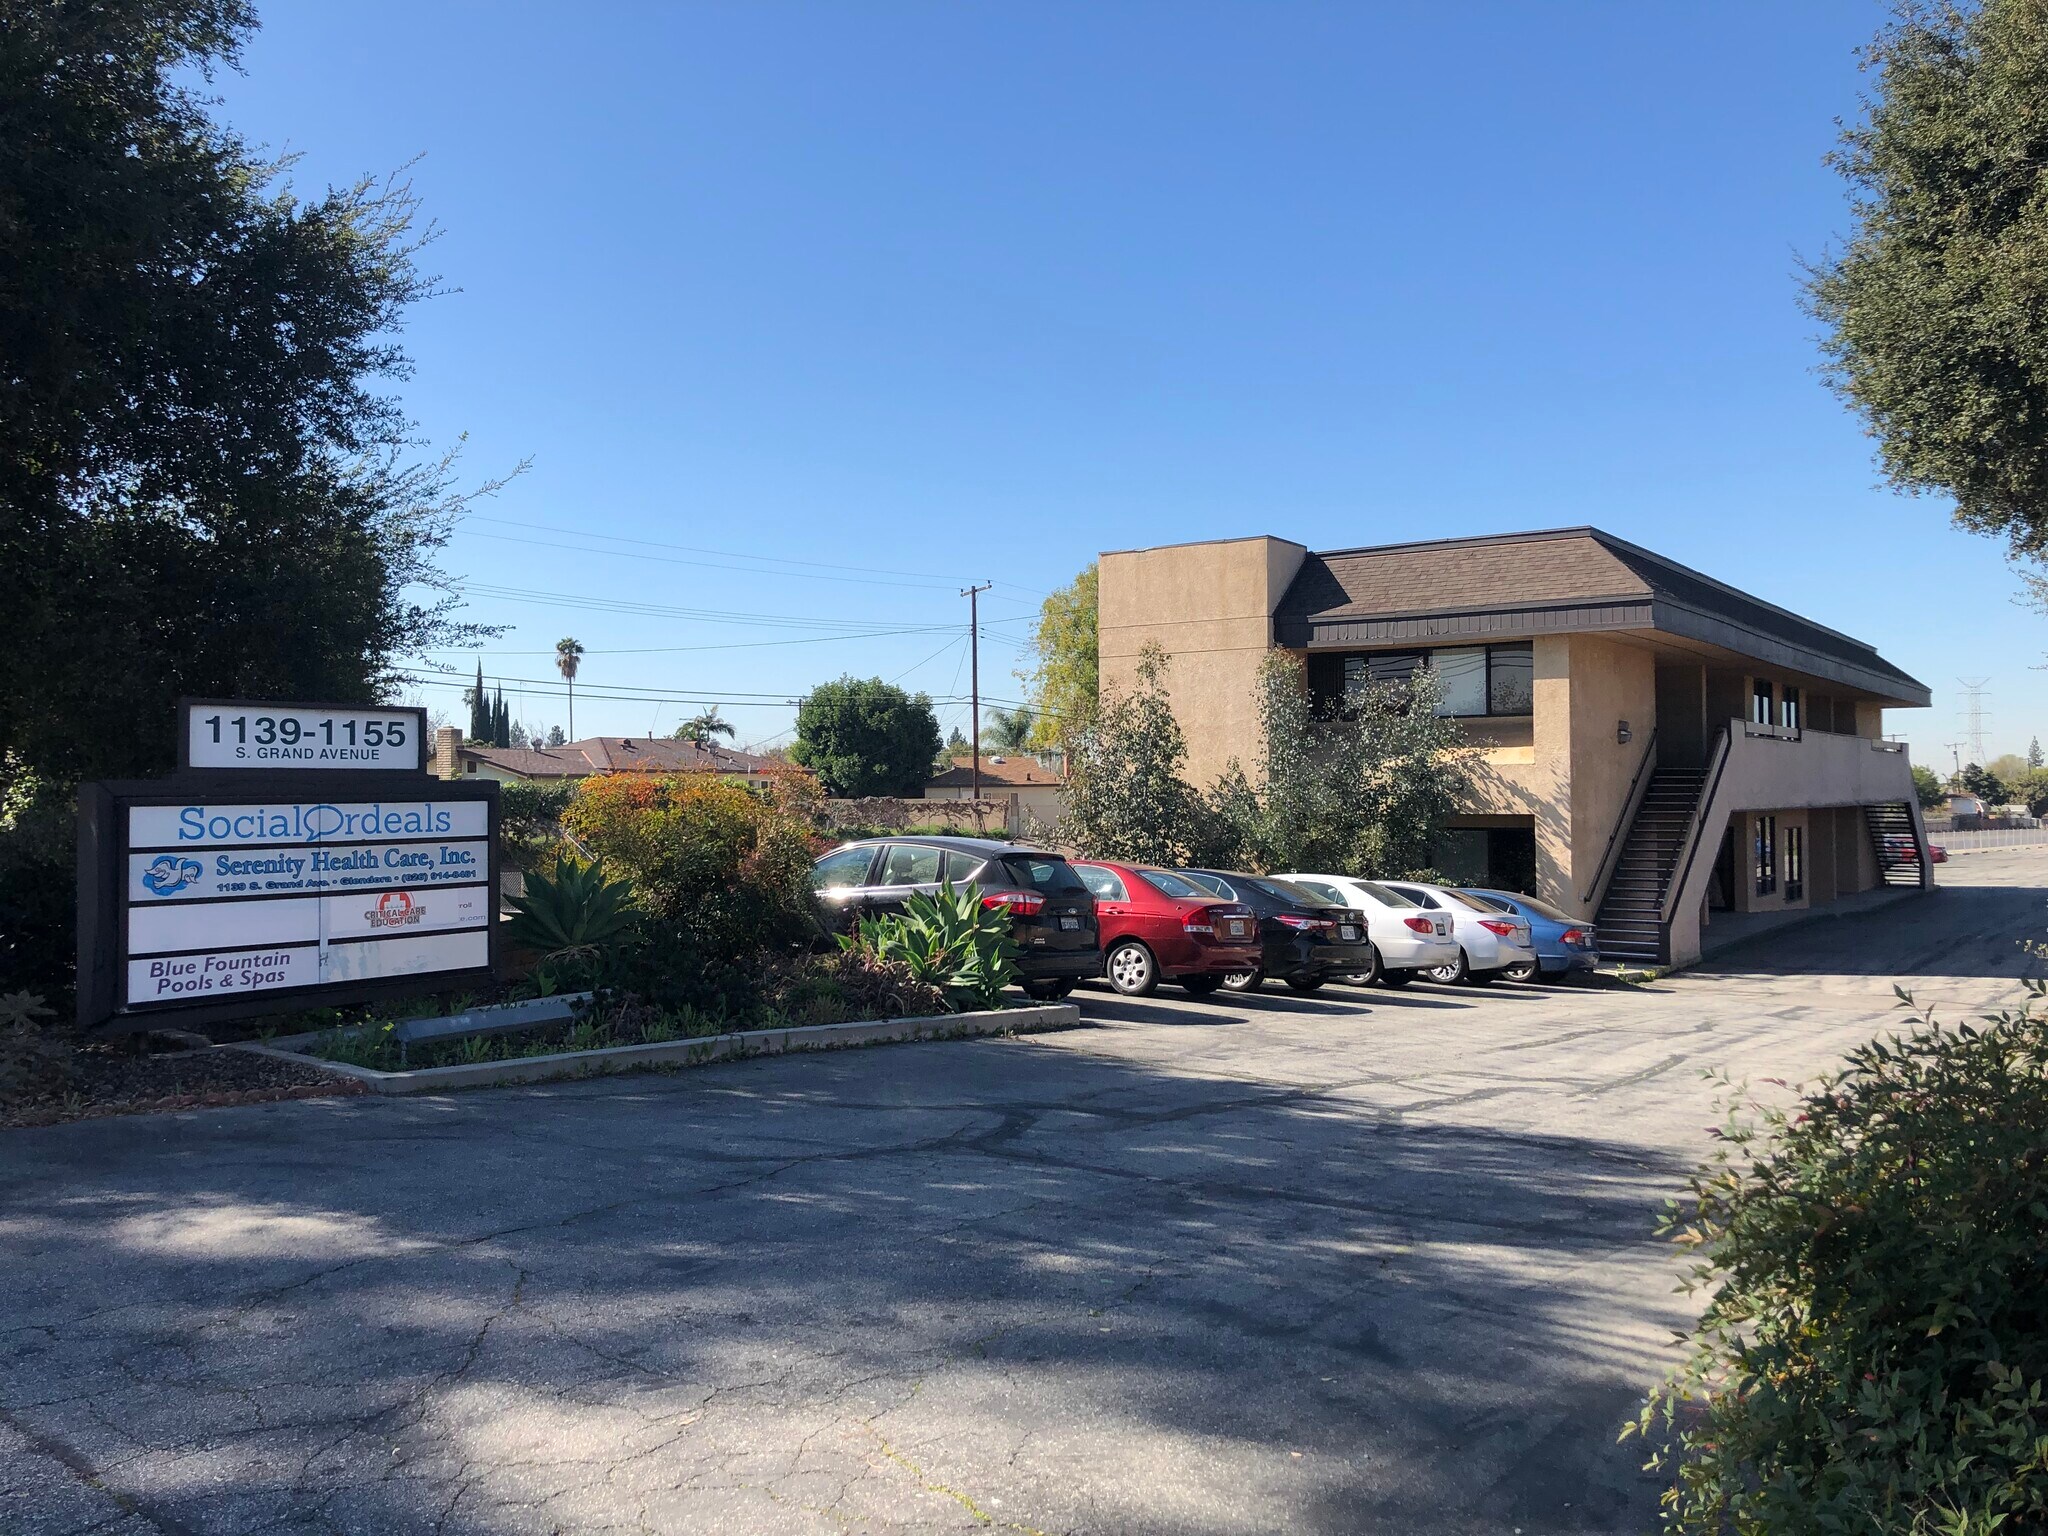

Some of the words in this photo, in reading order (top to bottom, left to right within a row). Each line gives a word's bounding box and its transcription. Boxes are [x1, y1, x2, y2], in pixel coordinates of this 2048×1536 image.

[205, 715, 406, 748] 1139-1155
[236, 747, 251, 759] S.
[257, 747, 315, 760] GRAND
[319, 748, 380, 761] AVENUE
[216, 854, 305, 880] Serenity
[310, 850, 379, 874] Health
[384, 848, 435, 871] Care,
[440, 846, 476, 867] Inc.
[216, 882, 246, 891] 1139
[249, 881, 262, 891] S.
[265, 879, 304, 889] Grand
[305, 878, 329, 888] Ave.
[340, 875, 392, 886] Glendora
[364, 909, 401, 921] CRITICAL
[401, 906, 427, 917] CARE
[370, 914, 421, 928] EDUCATION
[150, 960, 197, 979] Blue
[204, 952, 291, 973] Fountain
[157, 976, 213, 995] Pools
[219, 975, 233, 988] &
[240, 970, 286, 988] Spas
